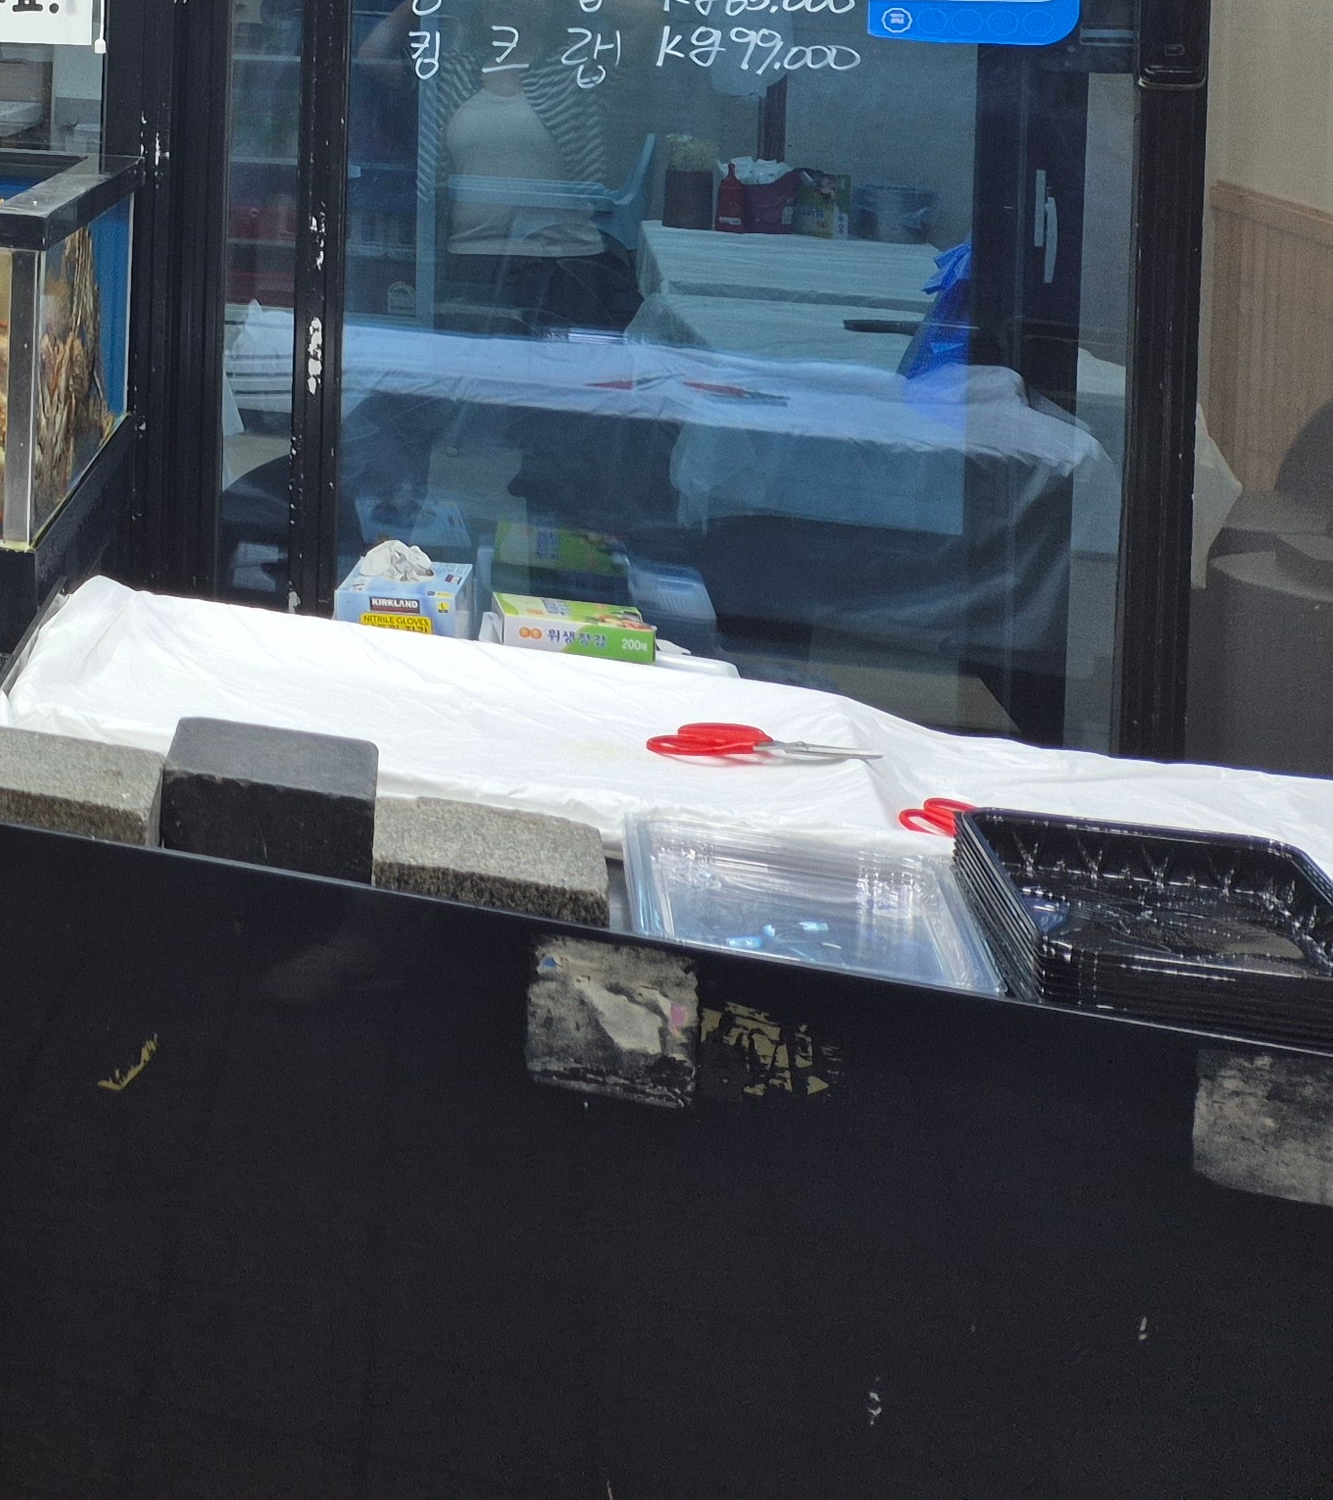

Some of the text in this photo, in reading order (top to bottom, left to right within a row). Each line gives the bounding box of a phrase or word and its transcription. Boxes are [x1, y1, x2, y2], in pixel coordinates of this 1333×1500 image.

[372, 598, 419, 609] KIRKLAND
[363, 615, 429, 626] NITRILE GLOVES
